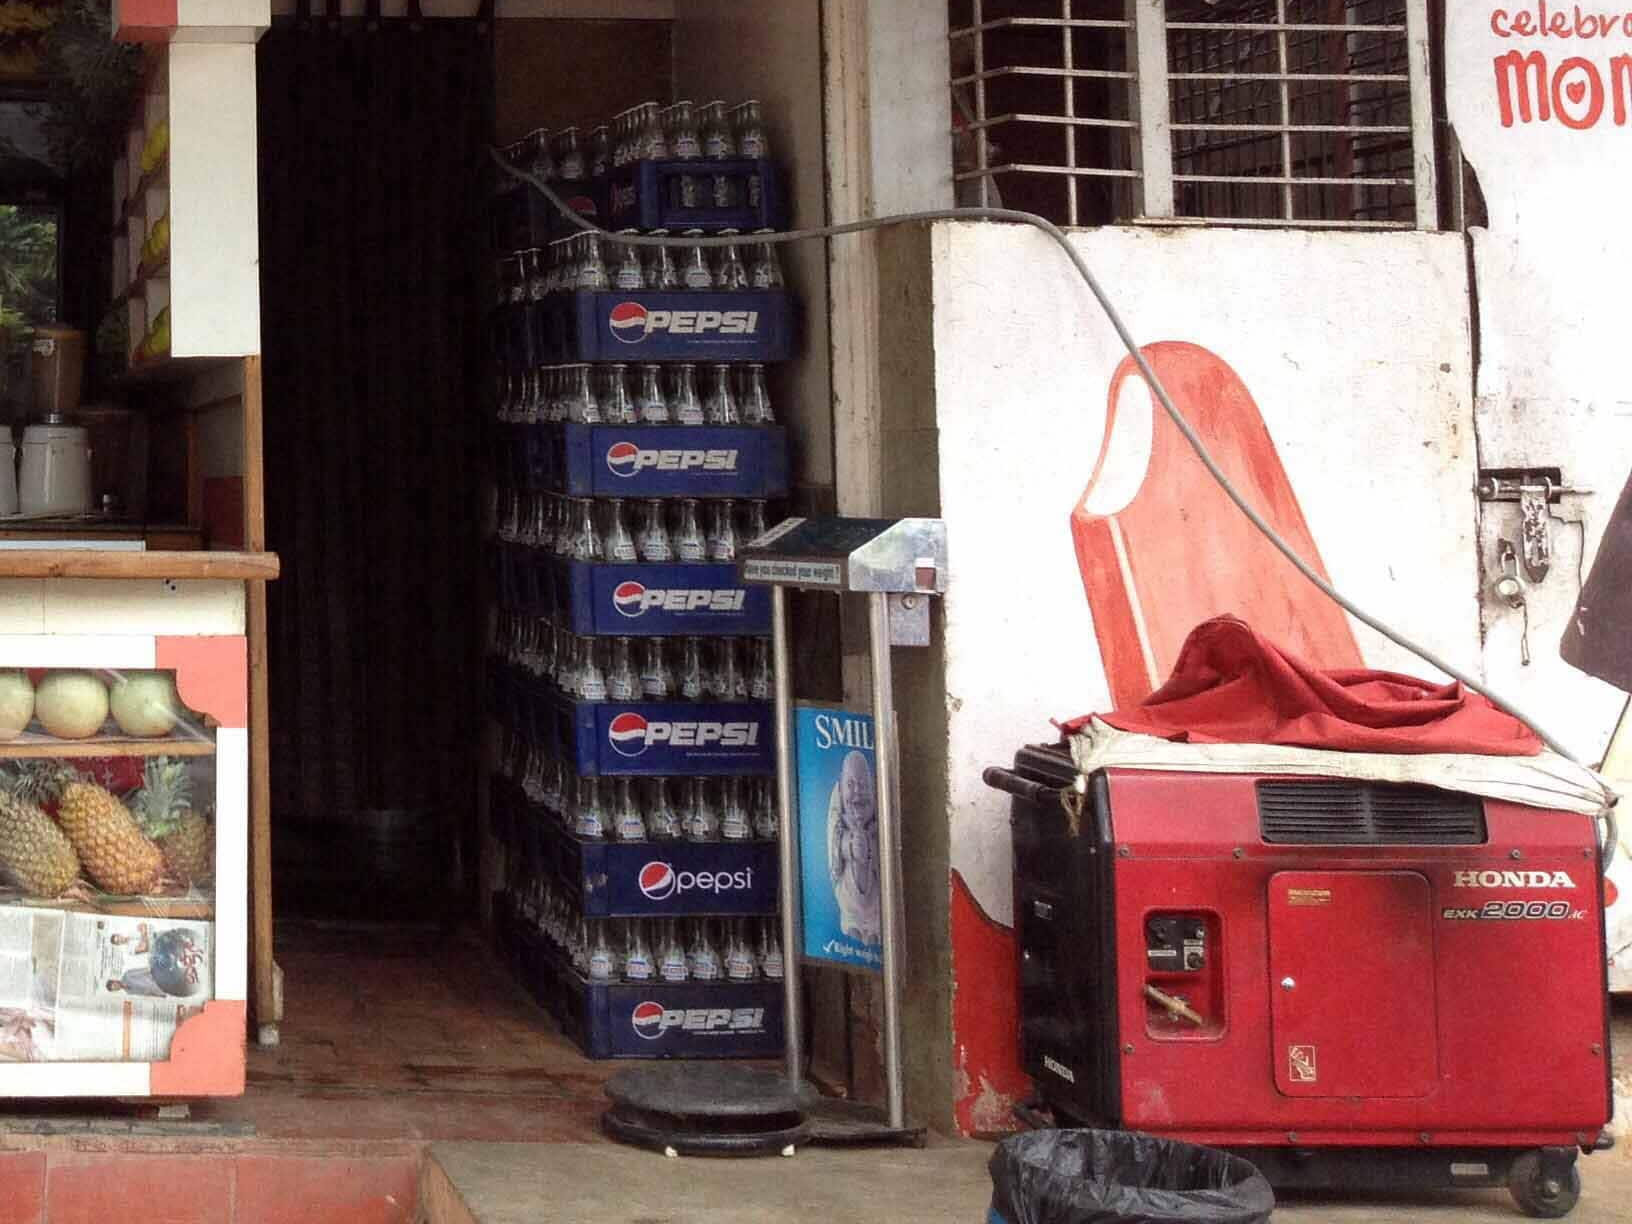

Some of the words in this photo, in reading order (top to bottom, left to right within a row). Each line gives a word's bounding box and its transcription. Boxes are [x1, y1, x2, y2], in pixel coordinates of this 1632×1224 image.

[644, 310, 758, 335] PEPSI
[633, 449, 738, 471] PEPSI
[641, 588, 746, 612] PEPSI
[644, 721, 759, 747] PEPSI
[815, 713, 874, 751] SMIL
[677, 866, 753, 894] pepsi
[1454, 871, 1576, 889] HONDA
[661, 1008, 766, 1030] PEPSI
